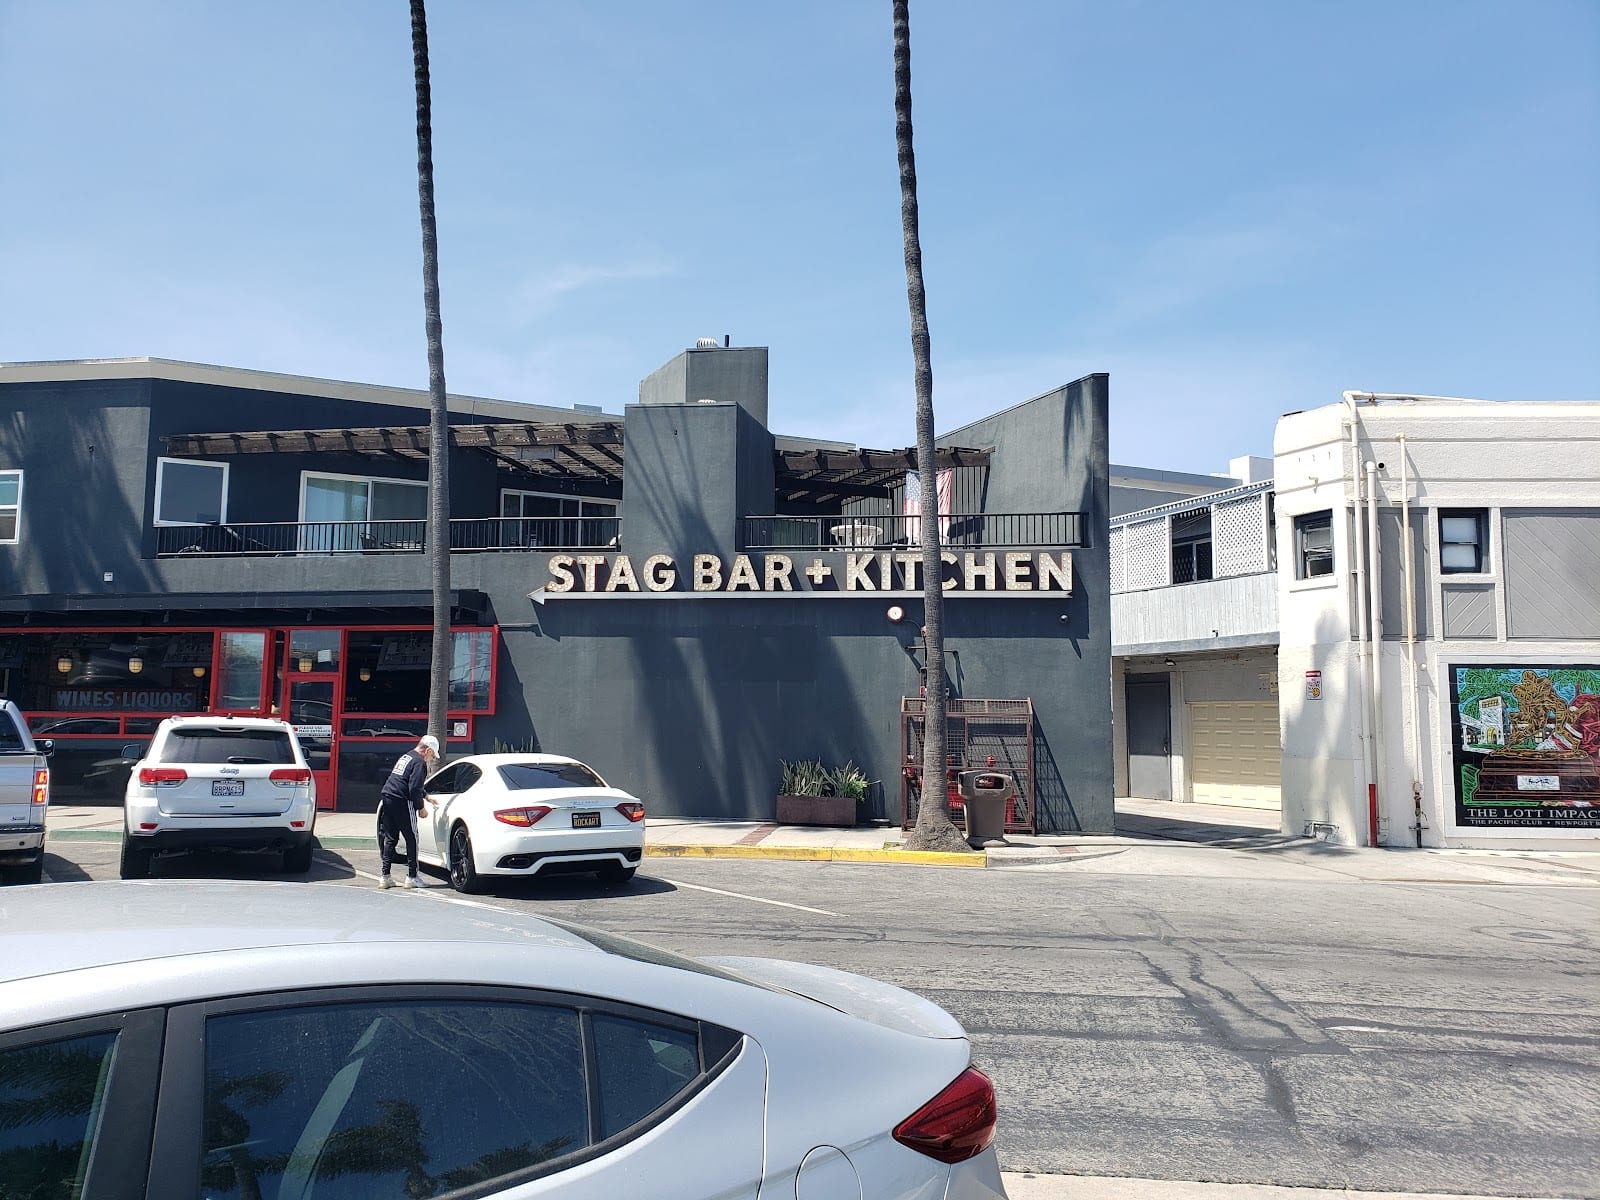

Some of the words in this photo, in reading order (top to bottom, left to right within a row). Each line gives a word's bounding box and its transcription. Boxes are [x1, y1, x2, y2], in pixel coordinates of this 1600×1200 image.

[547, 554, 676, 592] STAG
[693, 554, 793, 592] BAR
[805, 558, 831, 584] +
[846, 552, 1073, 591] KITCHEN
[56, 690, 115, 707] WINES
[122, 691, 193, 707] LIQUORS
[1467, 808, 1498, 818] THE
[1503, 809, 1544, 818] LOTT
[573, 818, 599, 827] ROCKART
